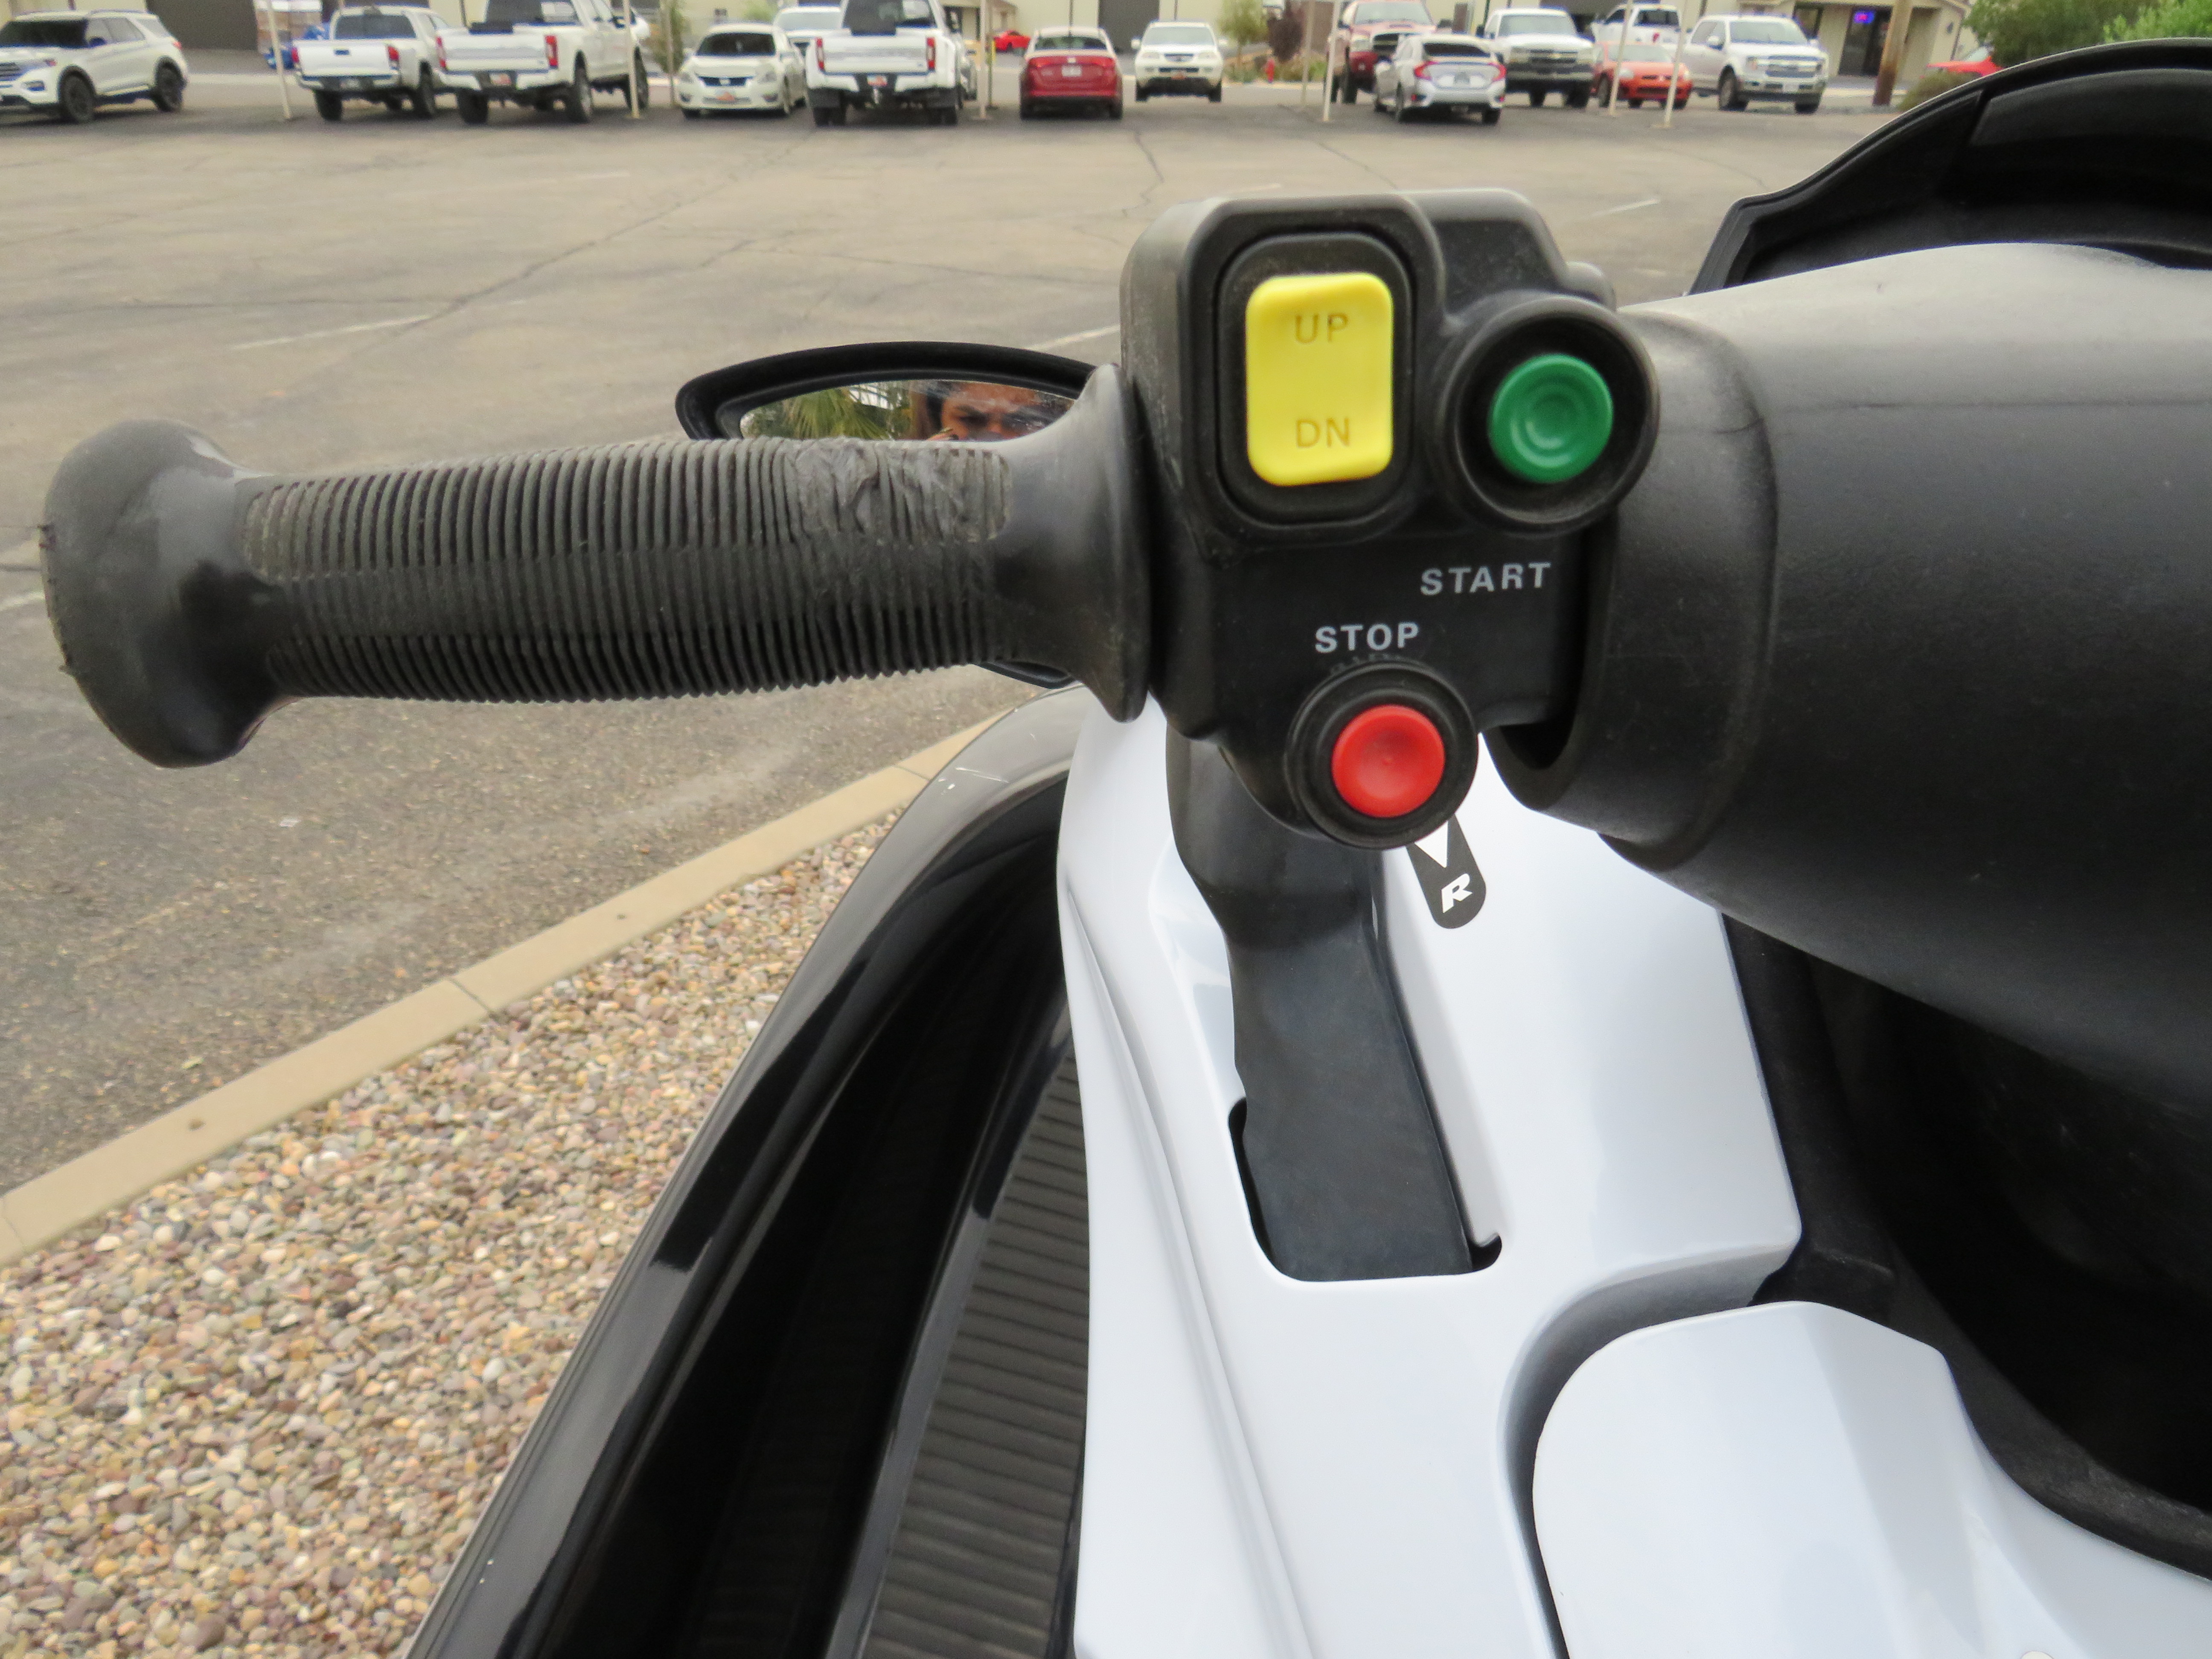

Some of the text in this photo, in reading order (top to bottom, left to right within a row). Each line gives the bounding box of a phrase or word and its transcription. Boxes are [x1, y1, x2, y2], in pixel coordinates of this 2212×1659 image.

[1295, 313, 1349, 343] UP
[1296, 417, 1350, 448] DN
[1420, 562, 1551, 596] START
[1315, 621, 1419, 654] STOP
[1441, 873, 1473, 913] R
